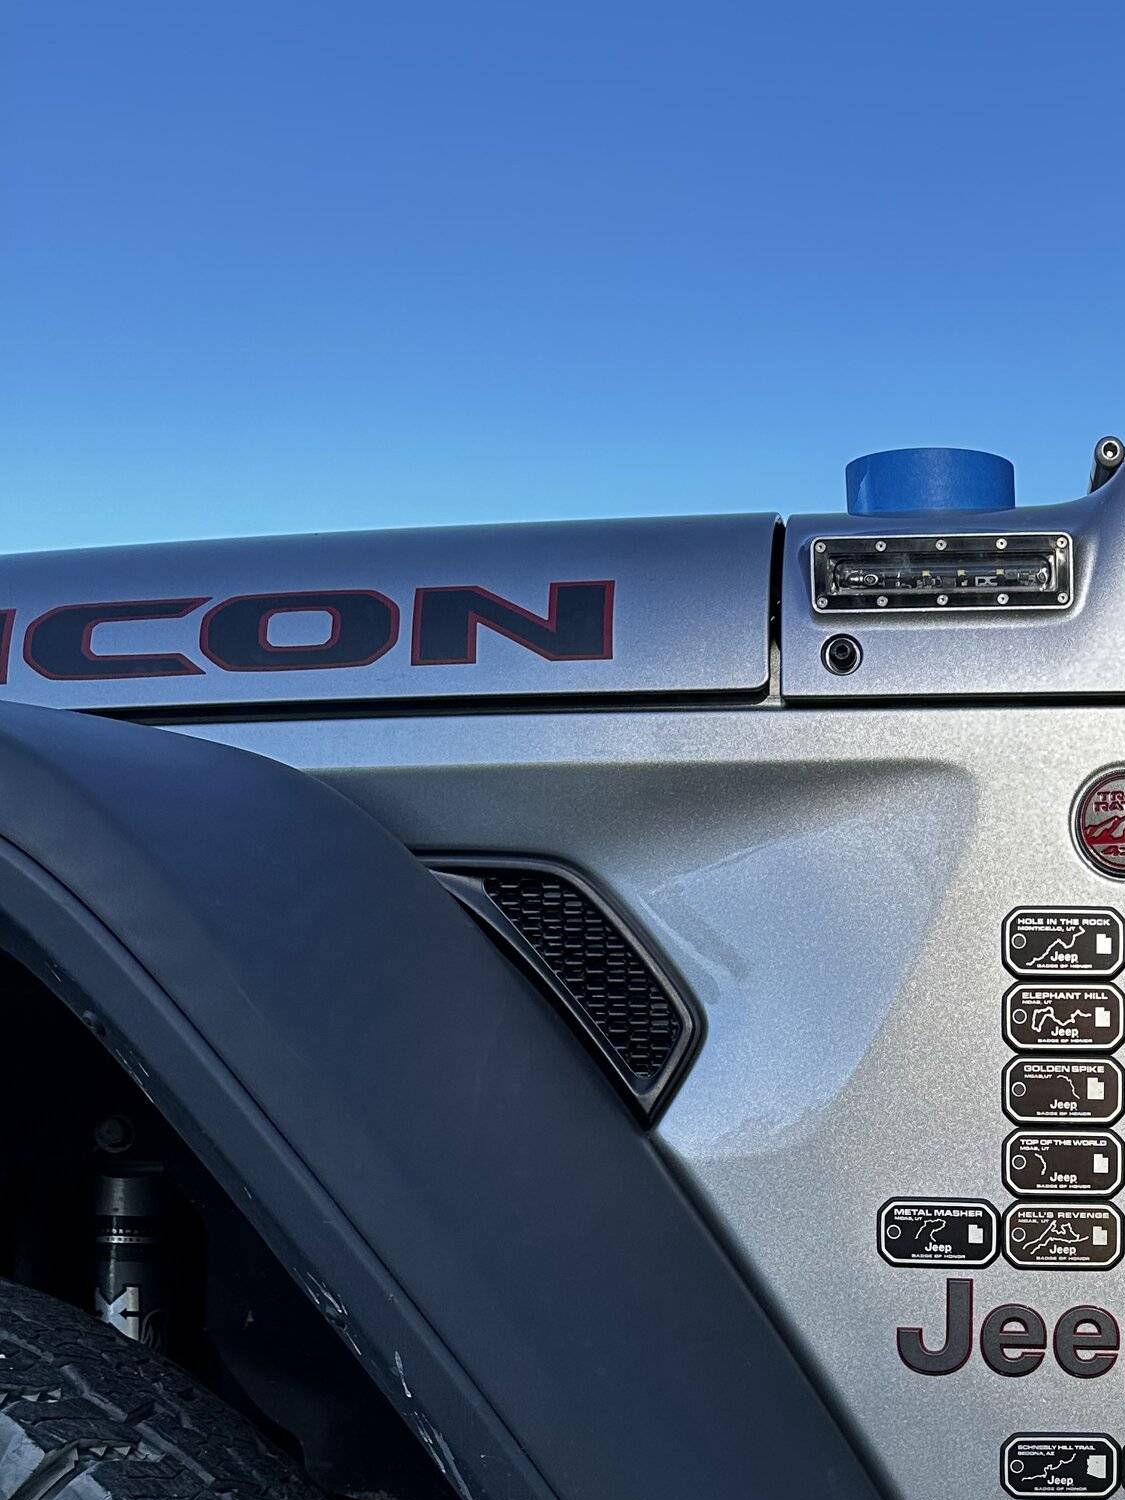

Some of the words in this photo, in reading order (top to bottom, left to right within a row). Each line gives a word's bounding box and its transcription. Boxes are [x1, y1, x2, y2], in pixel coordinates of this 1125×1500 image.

[0, 580, 615, 684] CON
[1050, 951, 1078, 963] Jeep
[1051, 1026, 1078, 1038] Jeep
[1050, 1100, 1077, 1111] Jeep
[1050, 1172, 1077, 1183] Jeep
[934, 1209, 982, 1217] MASHER
[925, 1242, 952, 1253] Jeep
[1050, 1245, 1076, 1255] Jeep
[1047, 1476, 1073, 1486] Jeep
